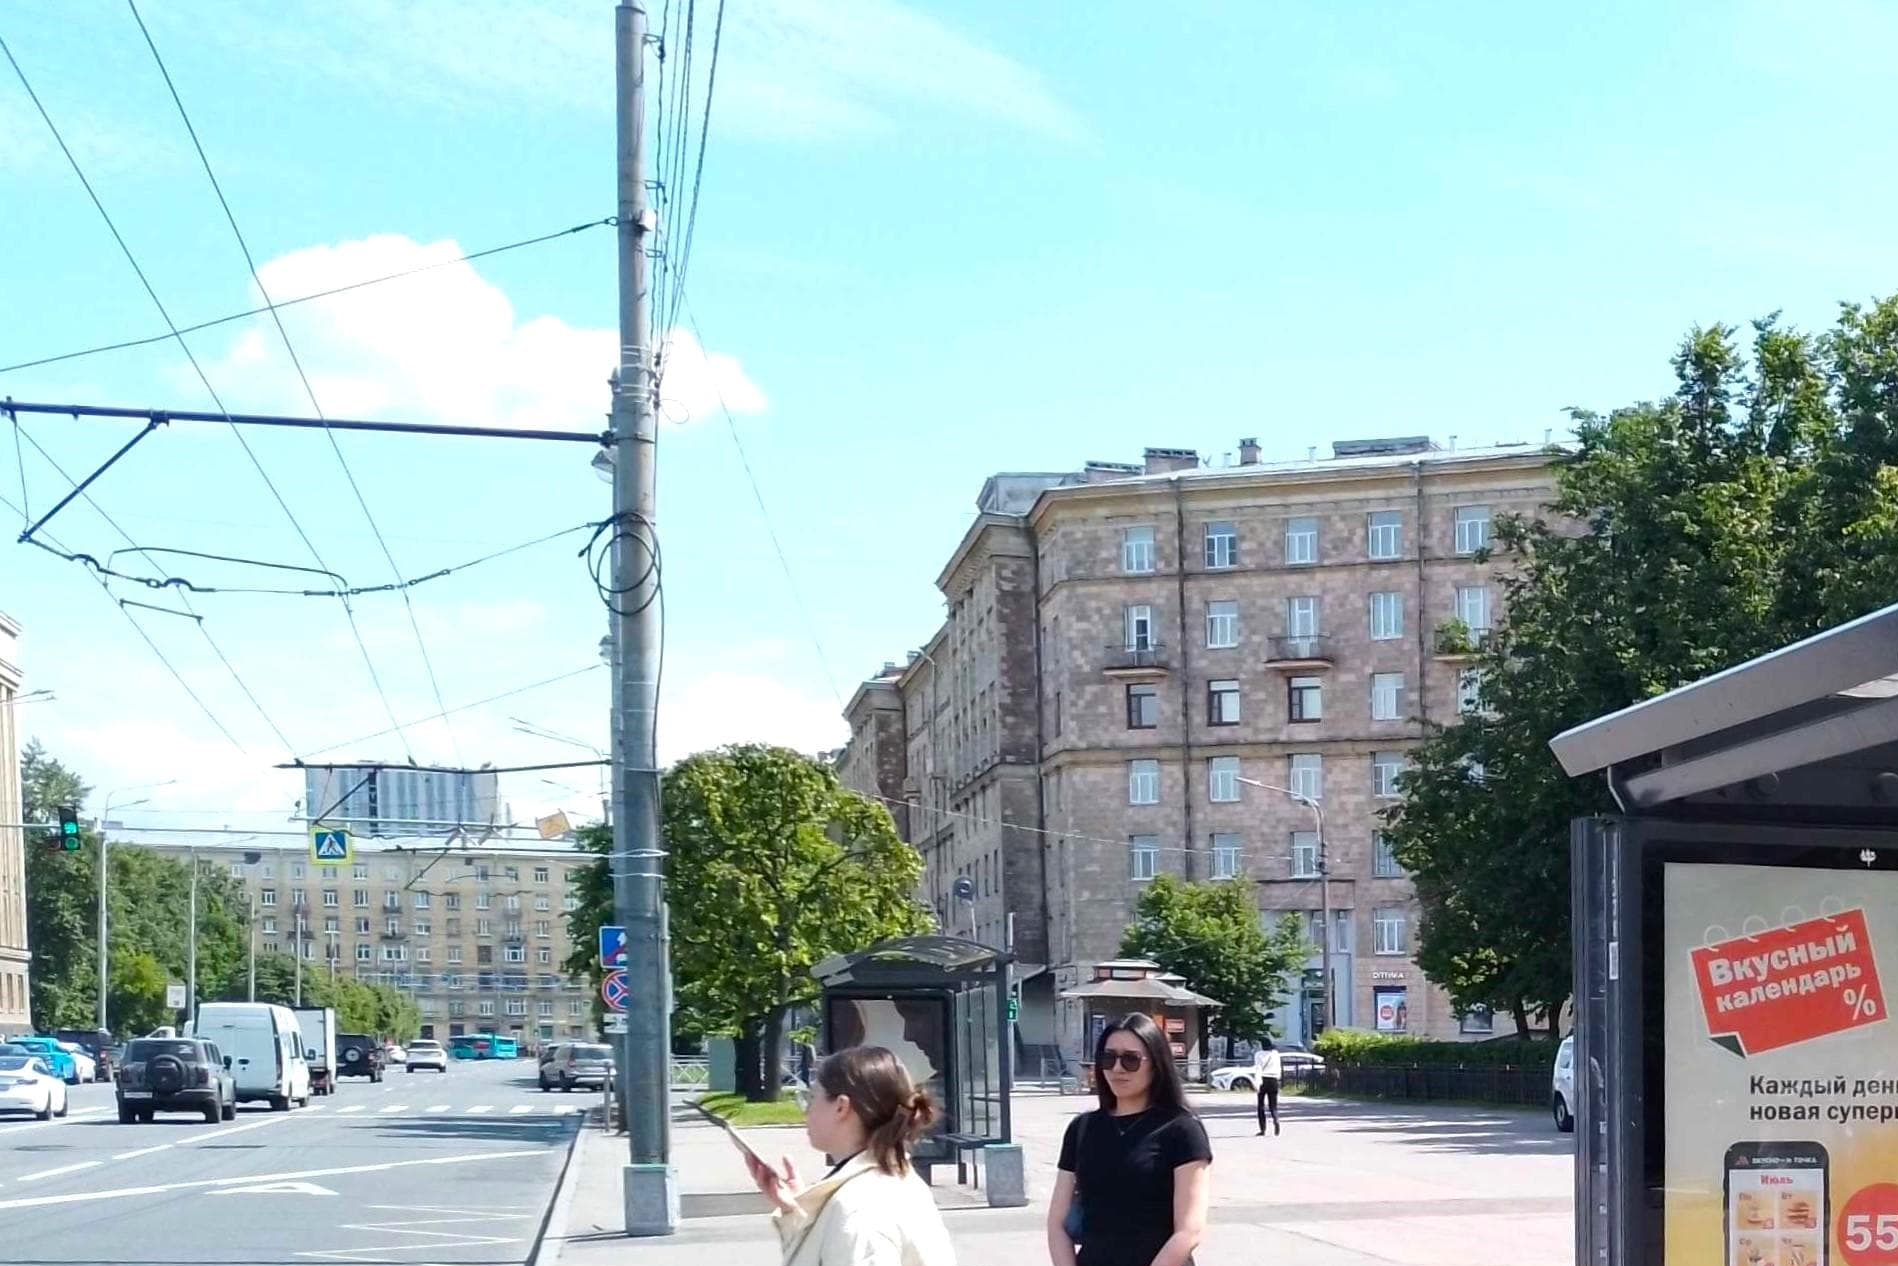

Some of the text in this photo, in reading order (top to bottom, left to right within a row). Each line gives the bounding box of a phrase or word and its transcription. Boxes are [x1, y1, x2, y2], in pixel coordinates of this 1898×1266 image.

[1708, 924, 1856, 987] Вкусный
[1715, 962, 1862, 1013] календарь
[1843, 983, 1877, 1021] %
[1749, 1075, 1846, 1098] Каждый
[1750, 1104, 1820, 1121] новая
[1760, 1175, 1793, 1184] Июль
